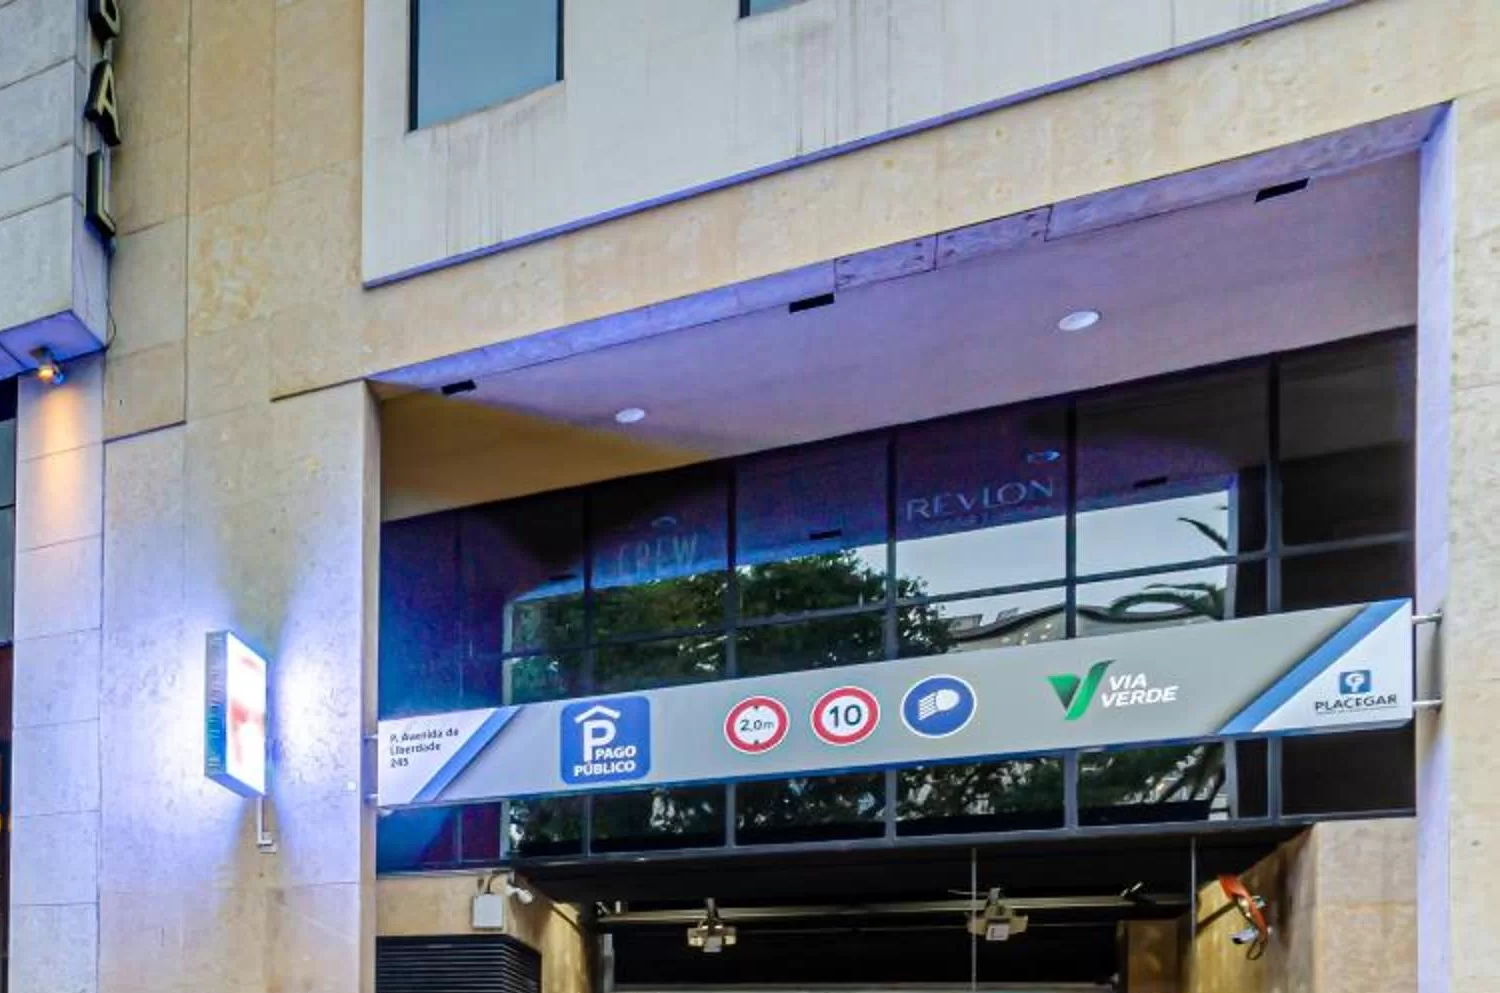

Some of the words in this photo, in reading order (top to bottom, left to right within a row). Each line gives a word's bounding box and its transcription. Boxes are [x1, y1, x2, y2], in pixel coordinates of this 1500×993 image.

[905, 480, 1054, 522] REVLON
[1109, 672, 1147, 691] VIA
[1101, 685, 1180, 708] VERDE
[829, 704, 863, 728] 10
[583, 719, 617, 762] P
[595, 745, 637, 760] PAGO
[573, 759, 637, 777] PÚBLICO
